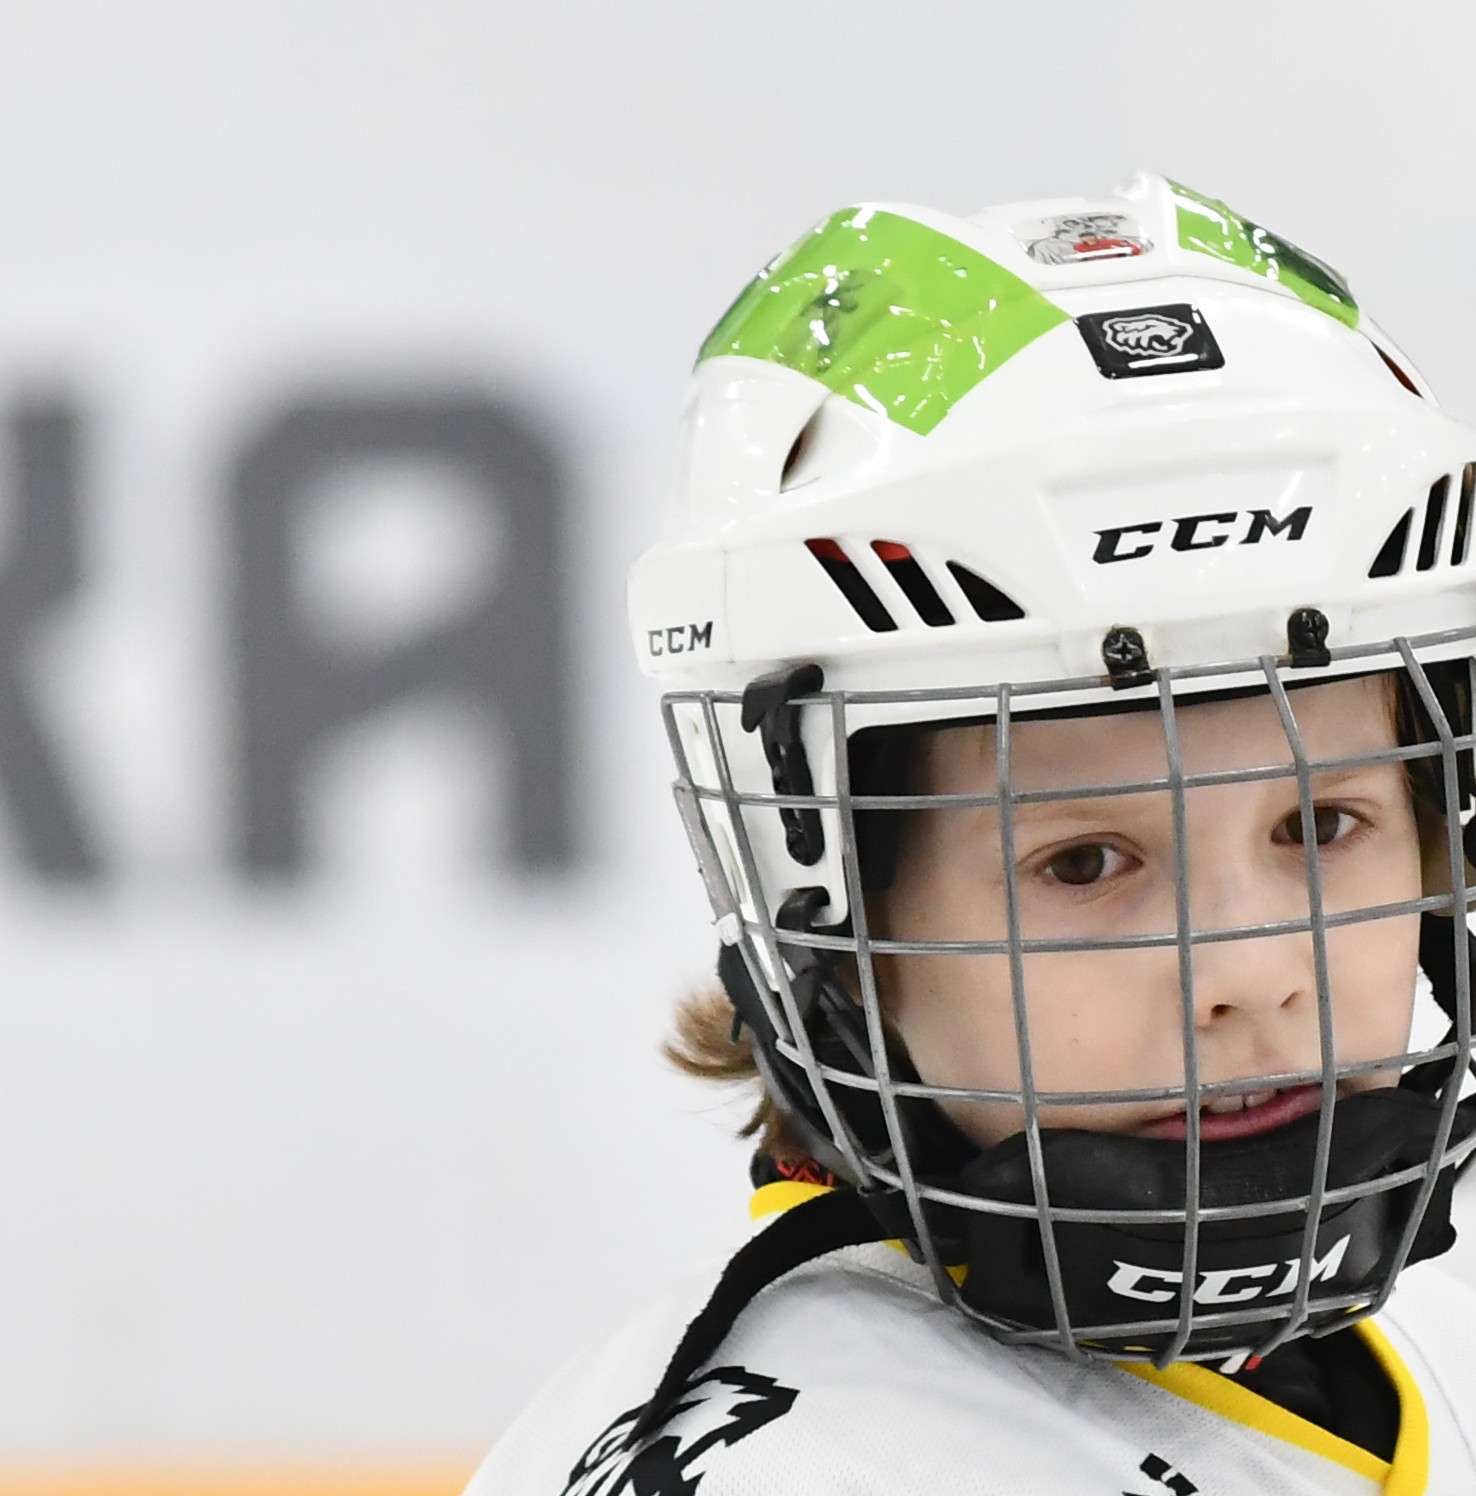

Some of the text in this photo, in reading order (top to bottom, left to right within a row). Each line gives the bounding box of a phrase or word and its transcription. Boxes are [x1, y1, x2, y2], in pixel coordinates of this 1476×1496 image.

[1091, 506, 1314, 565] CCM
[647, 620, 714, 657] CCM
[1106, 1234, 1352, 1305] CCM
